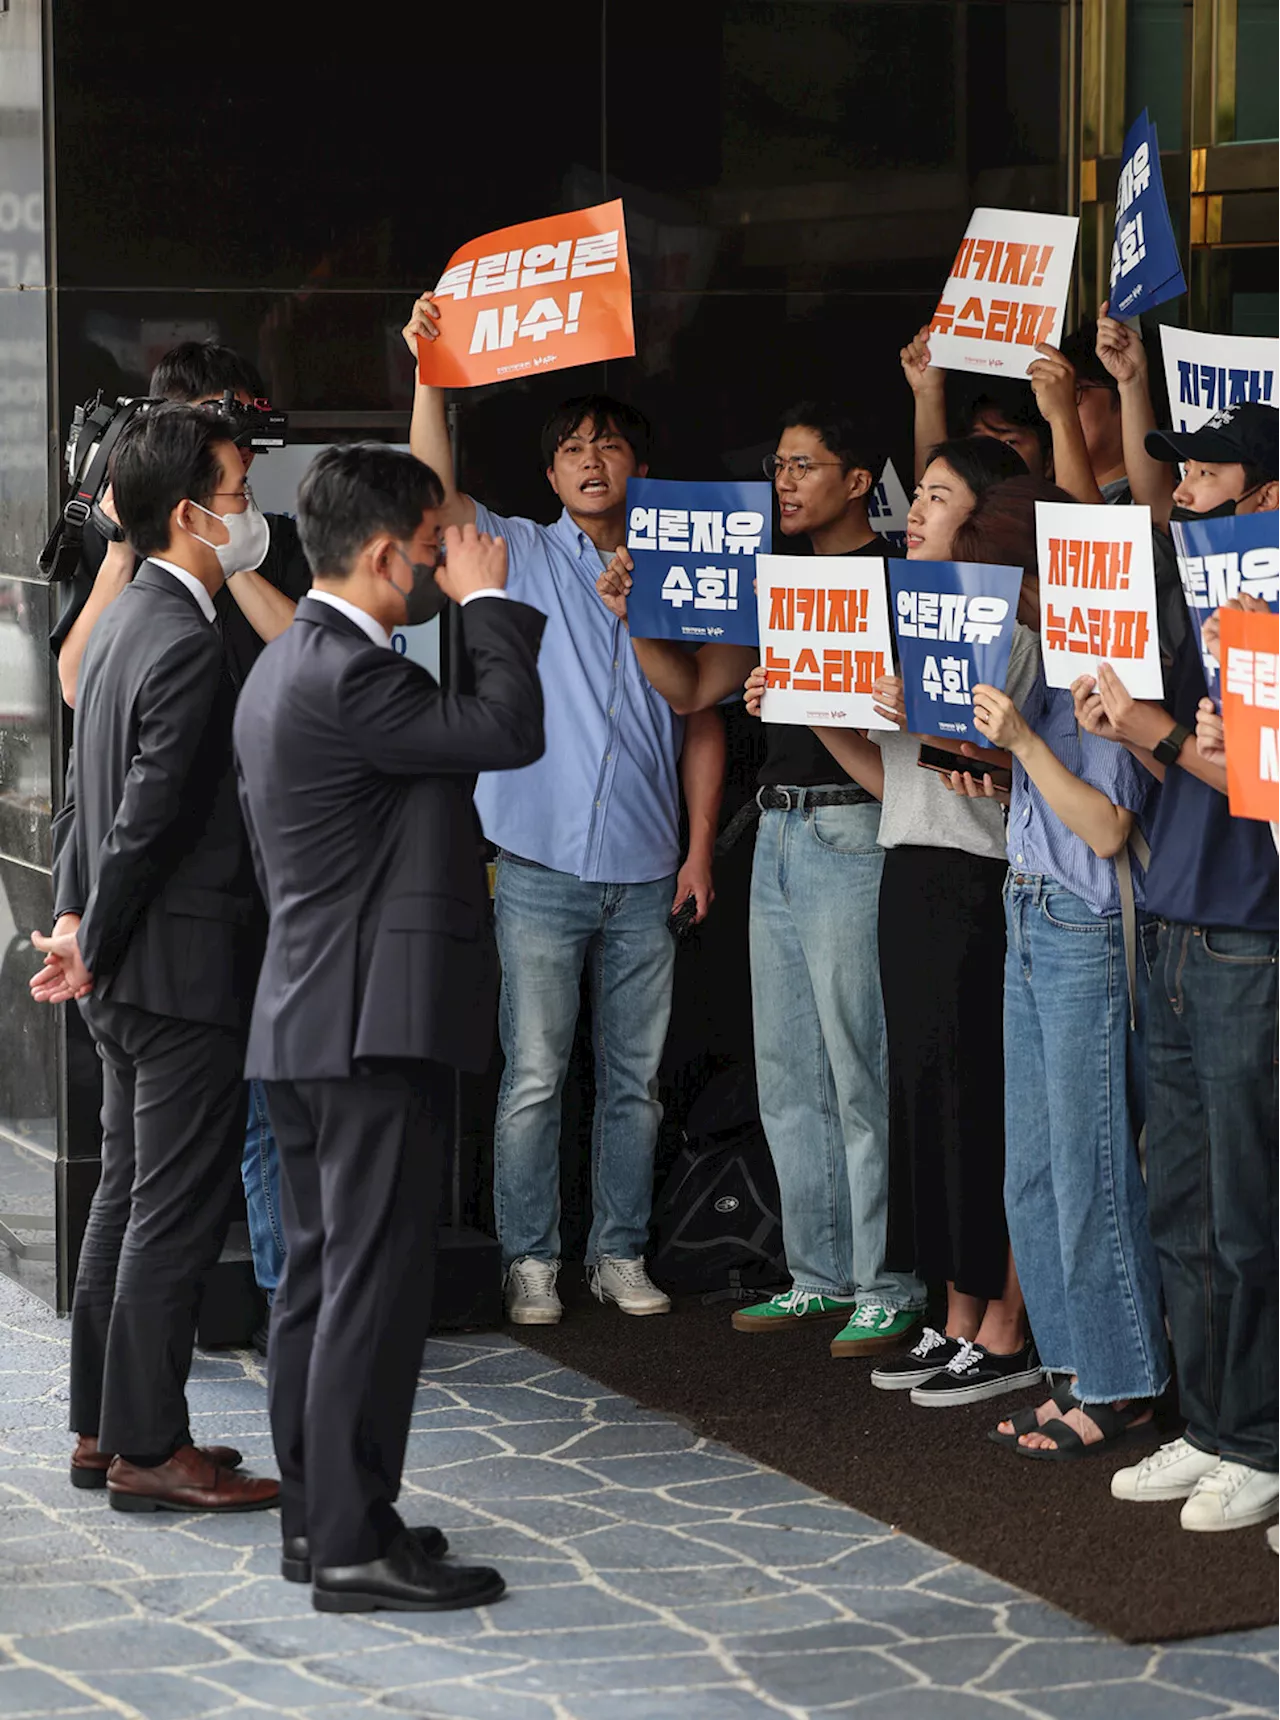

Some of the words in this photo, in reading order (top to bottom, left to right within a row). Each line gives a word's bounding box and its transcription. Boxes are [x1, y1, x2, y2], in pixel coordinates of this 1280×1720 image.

[433, 230, 619, 300] 독립언론
[469, 291, 583, 355] 사수!
[1177, 360, 1274, 411] 지키자!
[627, 507, 764, 555] 언론자유
[661, 566, 738, 611] 수호!
[1048, 538, 1132, 590] 지키자!
[769, 587, 869, 633] 지키자!
[897, 590, 1009, 644] 언론자유
[1046, 604, 1149, 659] 뉴스타파
[766, 647, 885, 694] 뉴스타파
[922, 655, 971, 706] 수호!
